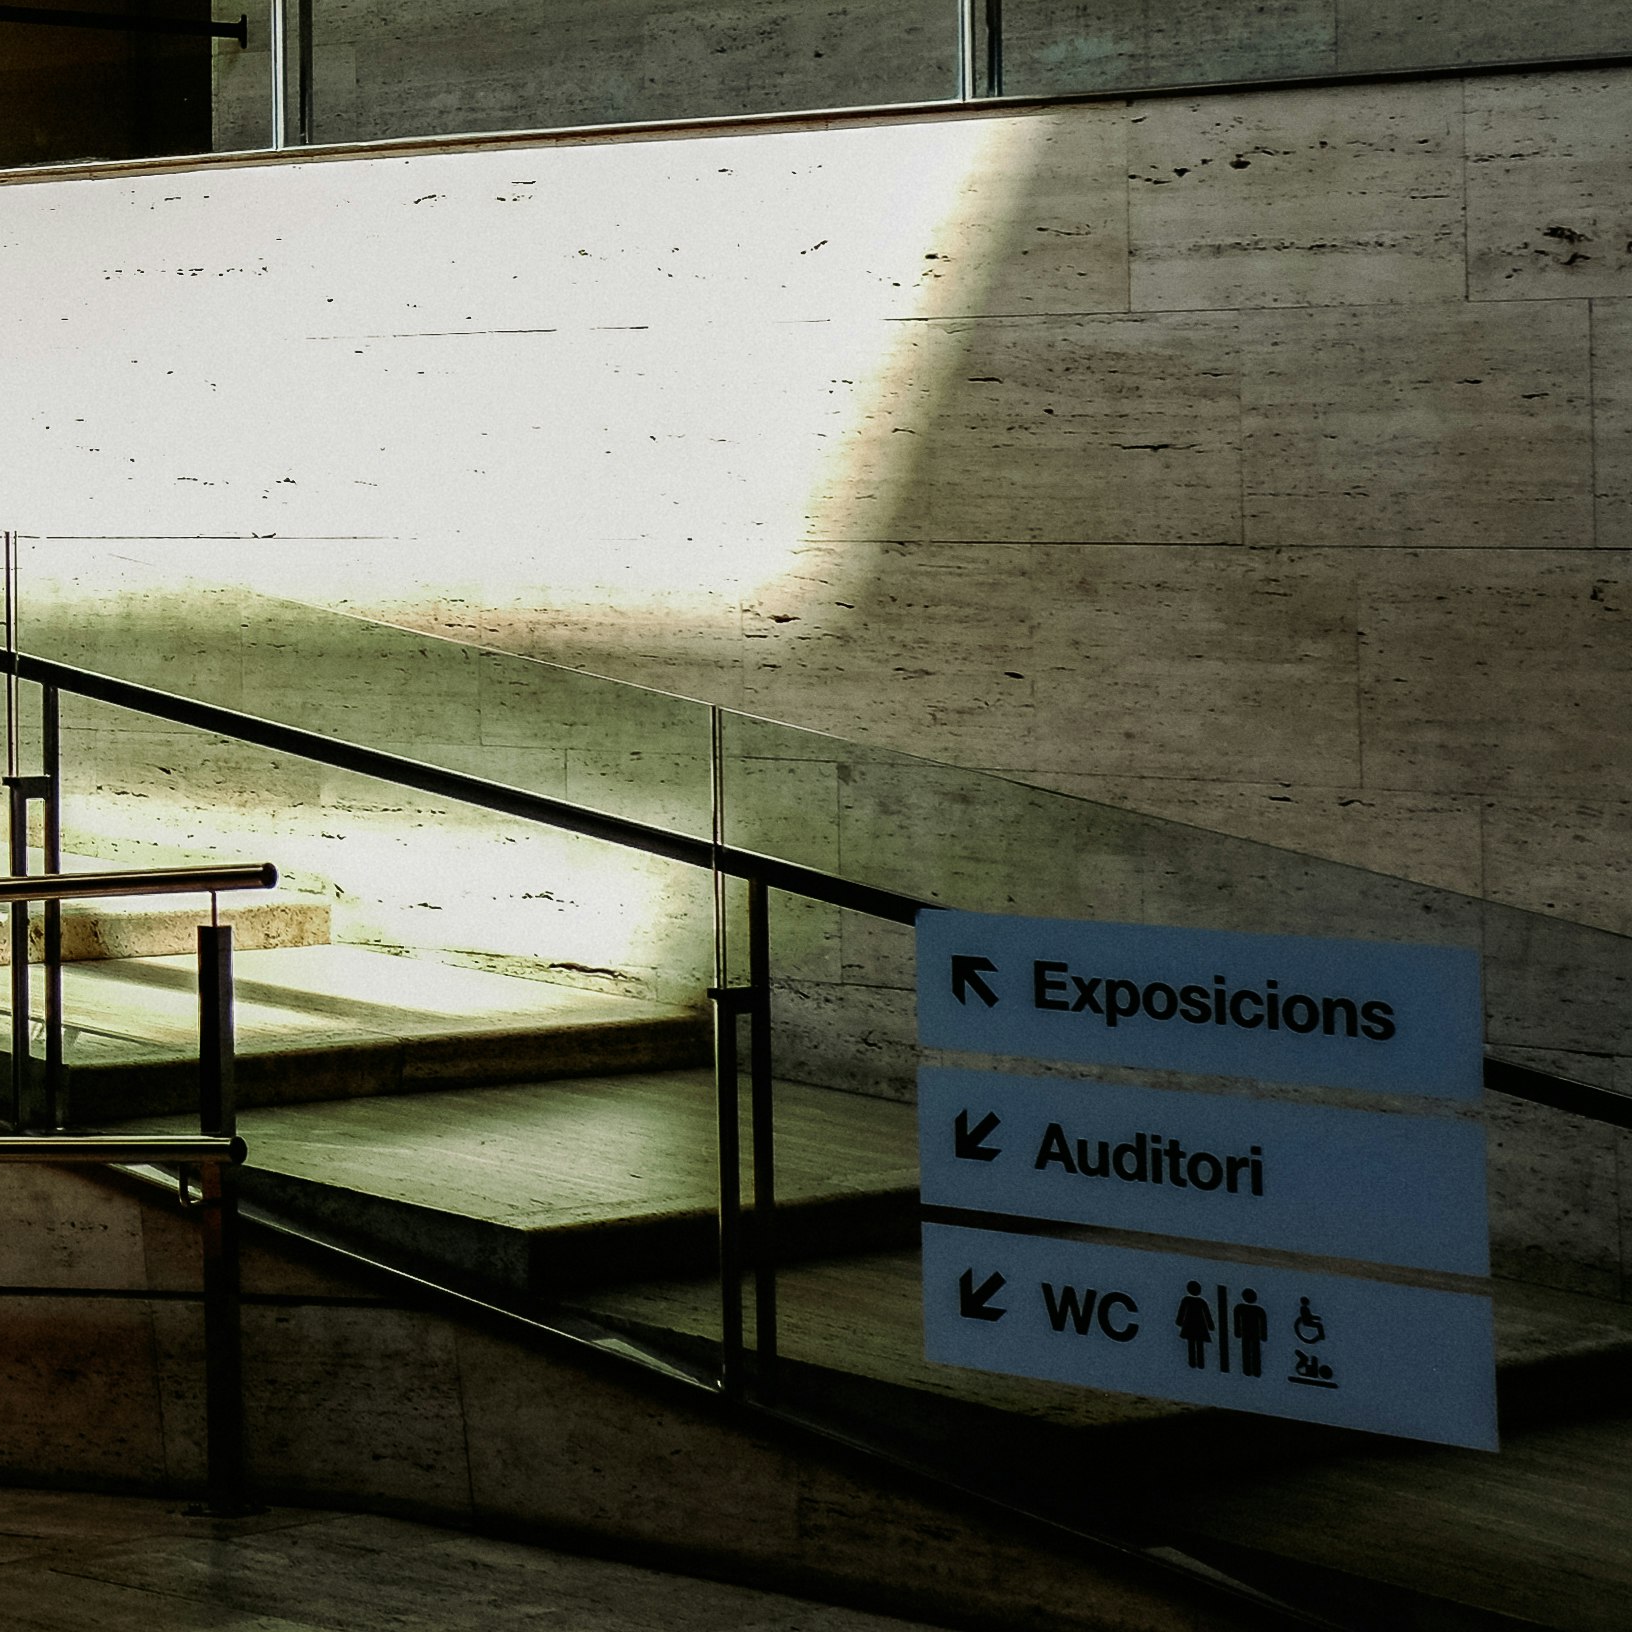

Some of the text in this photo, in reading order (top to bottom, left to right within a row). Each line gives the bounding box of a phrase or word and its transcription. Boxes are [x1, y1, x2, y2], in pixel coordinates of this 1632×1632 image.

[1033, 960, 1397, 1041] Exposicions
[1034, 1123, 1264, 1196] Auditori
[1041, 1282, 1140, 1343] WC
